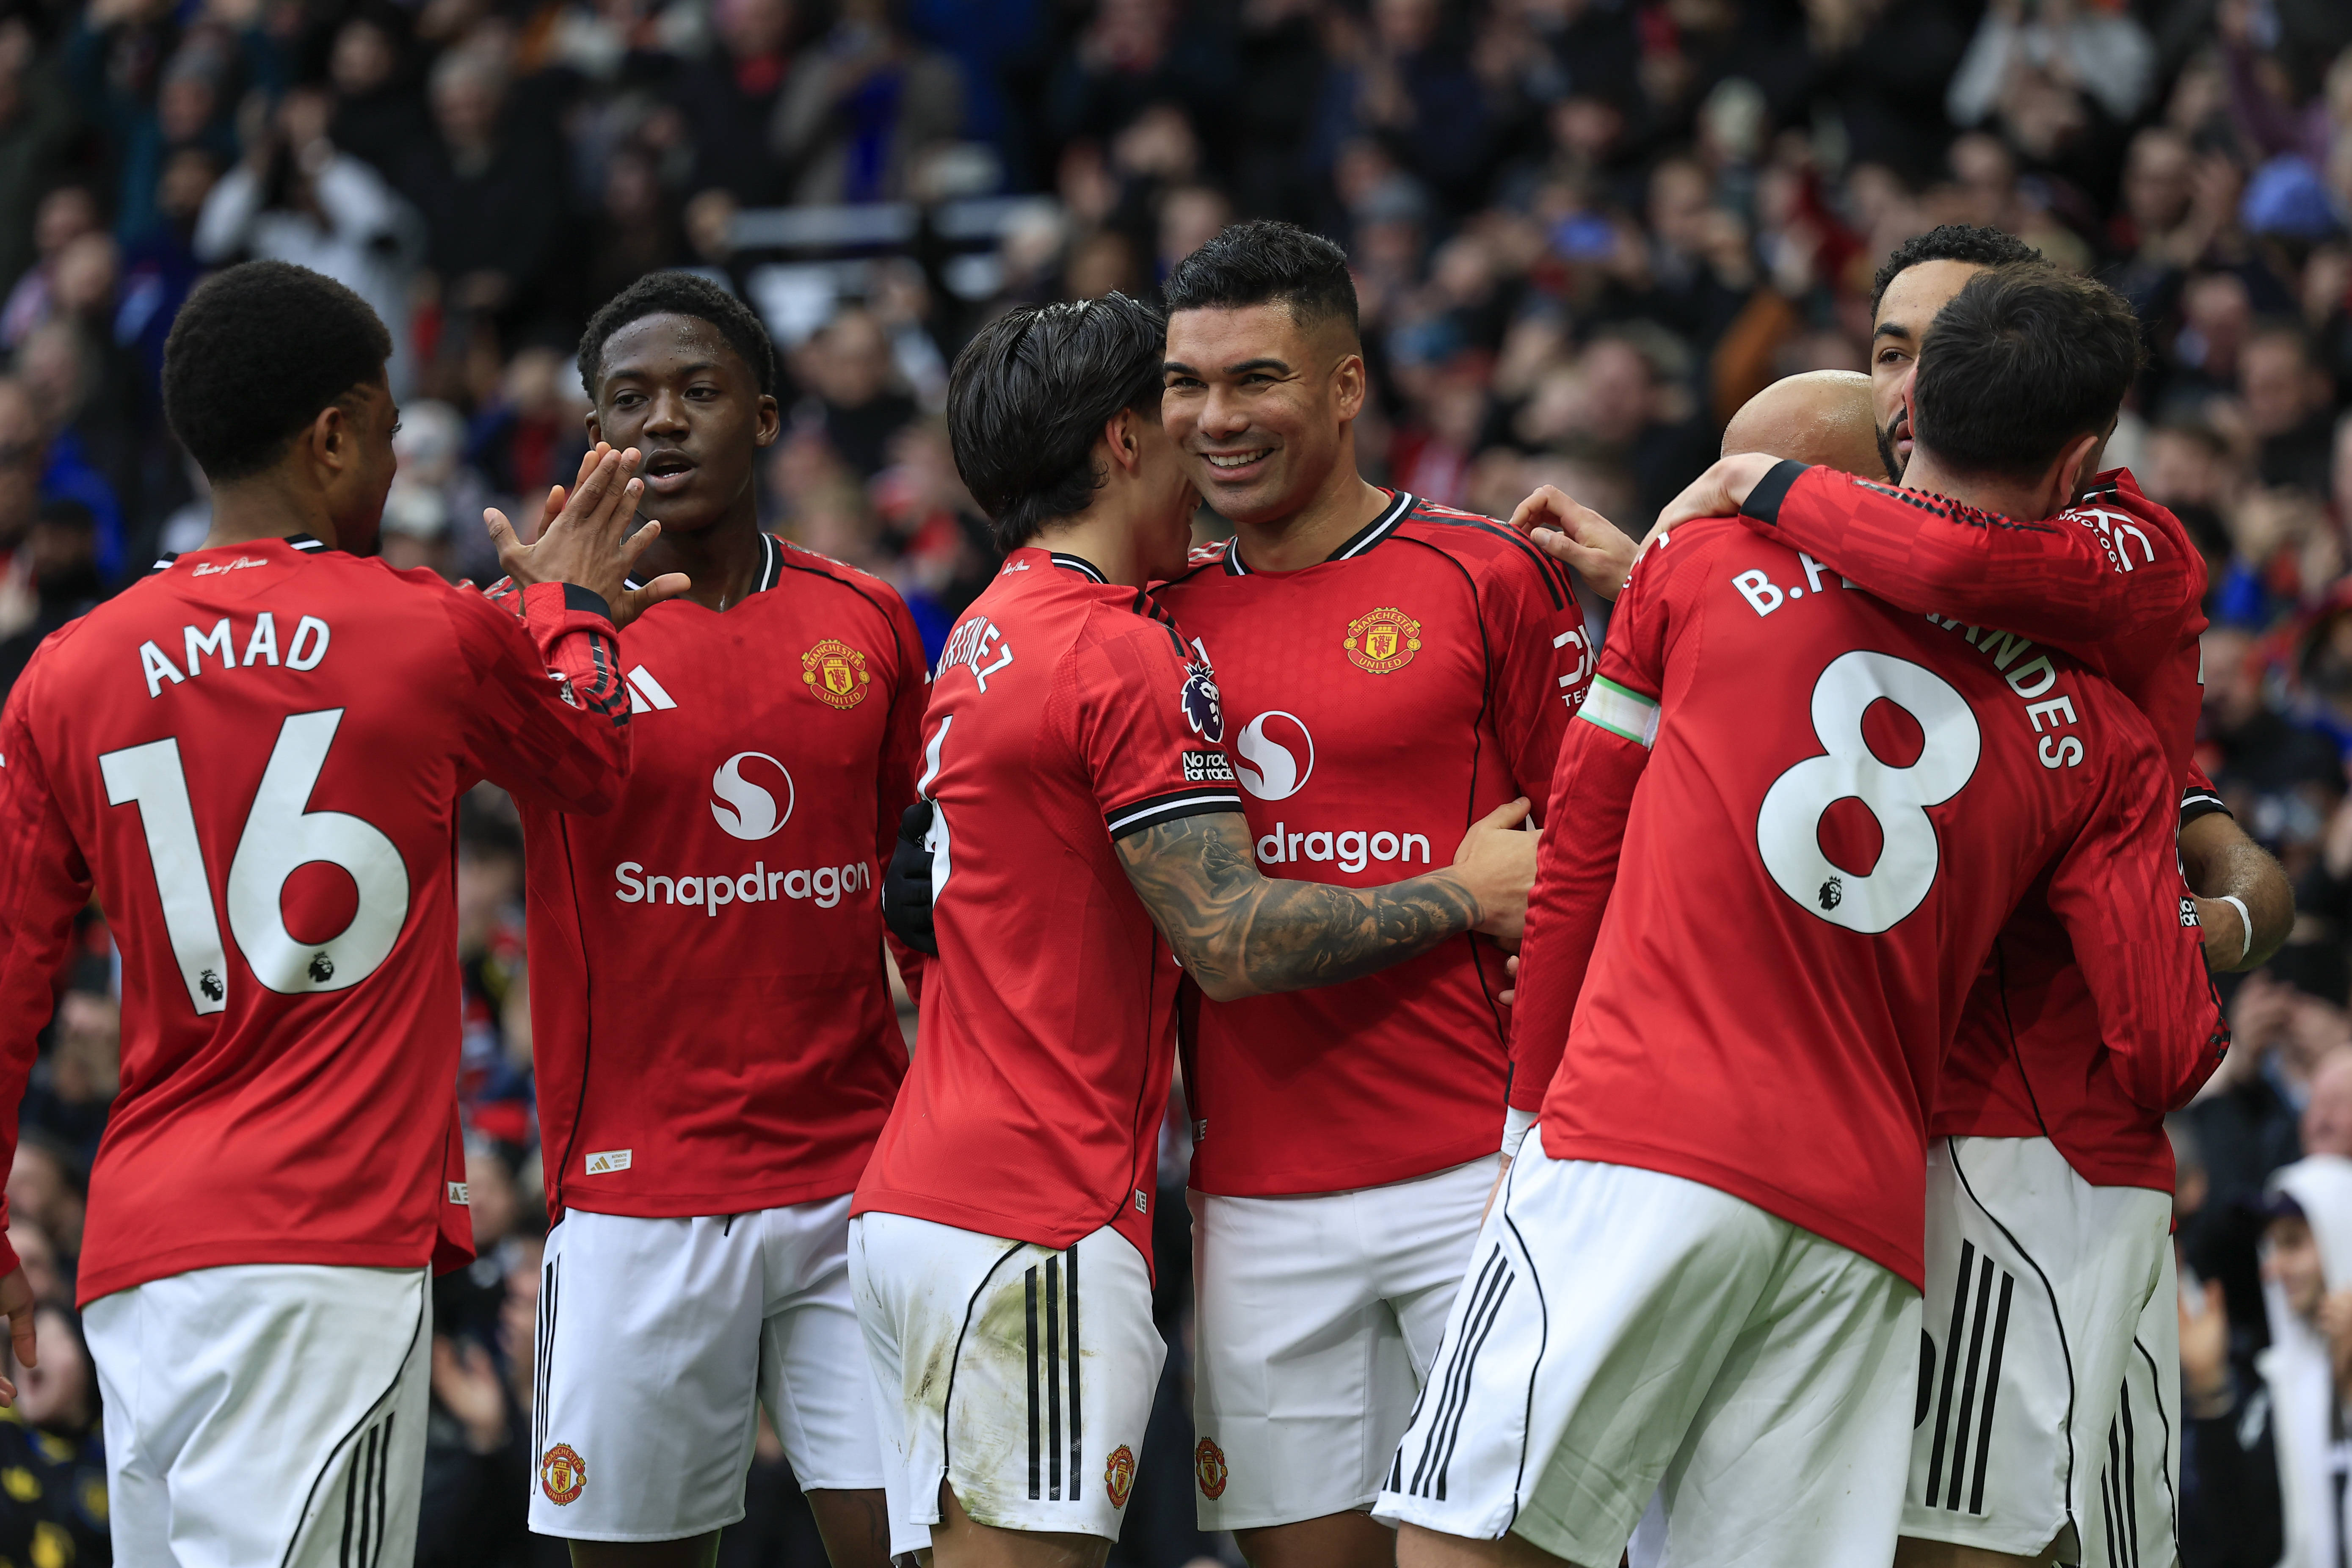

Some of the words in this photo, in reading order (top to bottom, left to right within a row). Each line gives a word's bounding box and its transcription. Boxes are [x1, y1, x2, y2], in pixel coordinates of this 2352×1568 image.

[2051, 513, 2123, 574] HNOLOGY
[1353, 612, 1415, 634] MANCHESTER
[139, 612, 331, 698] AMAD
[808, 644, 861, 667] MANCHESTER
[1358, 657, 1402, 669] UNITED
[823, 693, 861, 704] UNITED
[1182, 752, 1204, 767] No
[1206, 754, 1228, 767] roo
[1184, 766, 1204, 781] for
[1206, 768, 1236, 780] racis
[1756, 650, 1982, 934] 8
[1256, 822, 1430, 873] dragon
[98, 707, 411, 1016] 16
[615, 861, 870, 917] Snapdragon
[545, 1448, 581, 1470] MANCHESTER
[548, 1489, 574, 1501] UNITED
[1111, 1492, 1125, 1505] UNITED
[1204, 1485, 1222, 1496] UNITED
